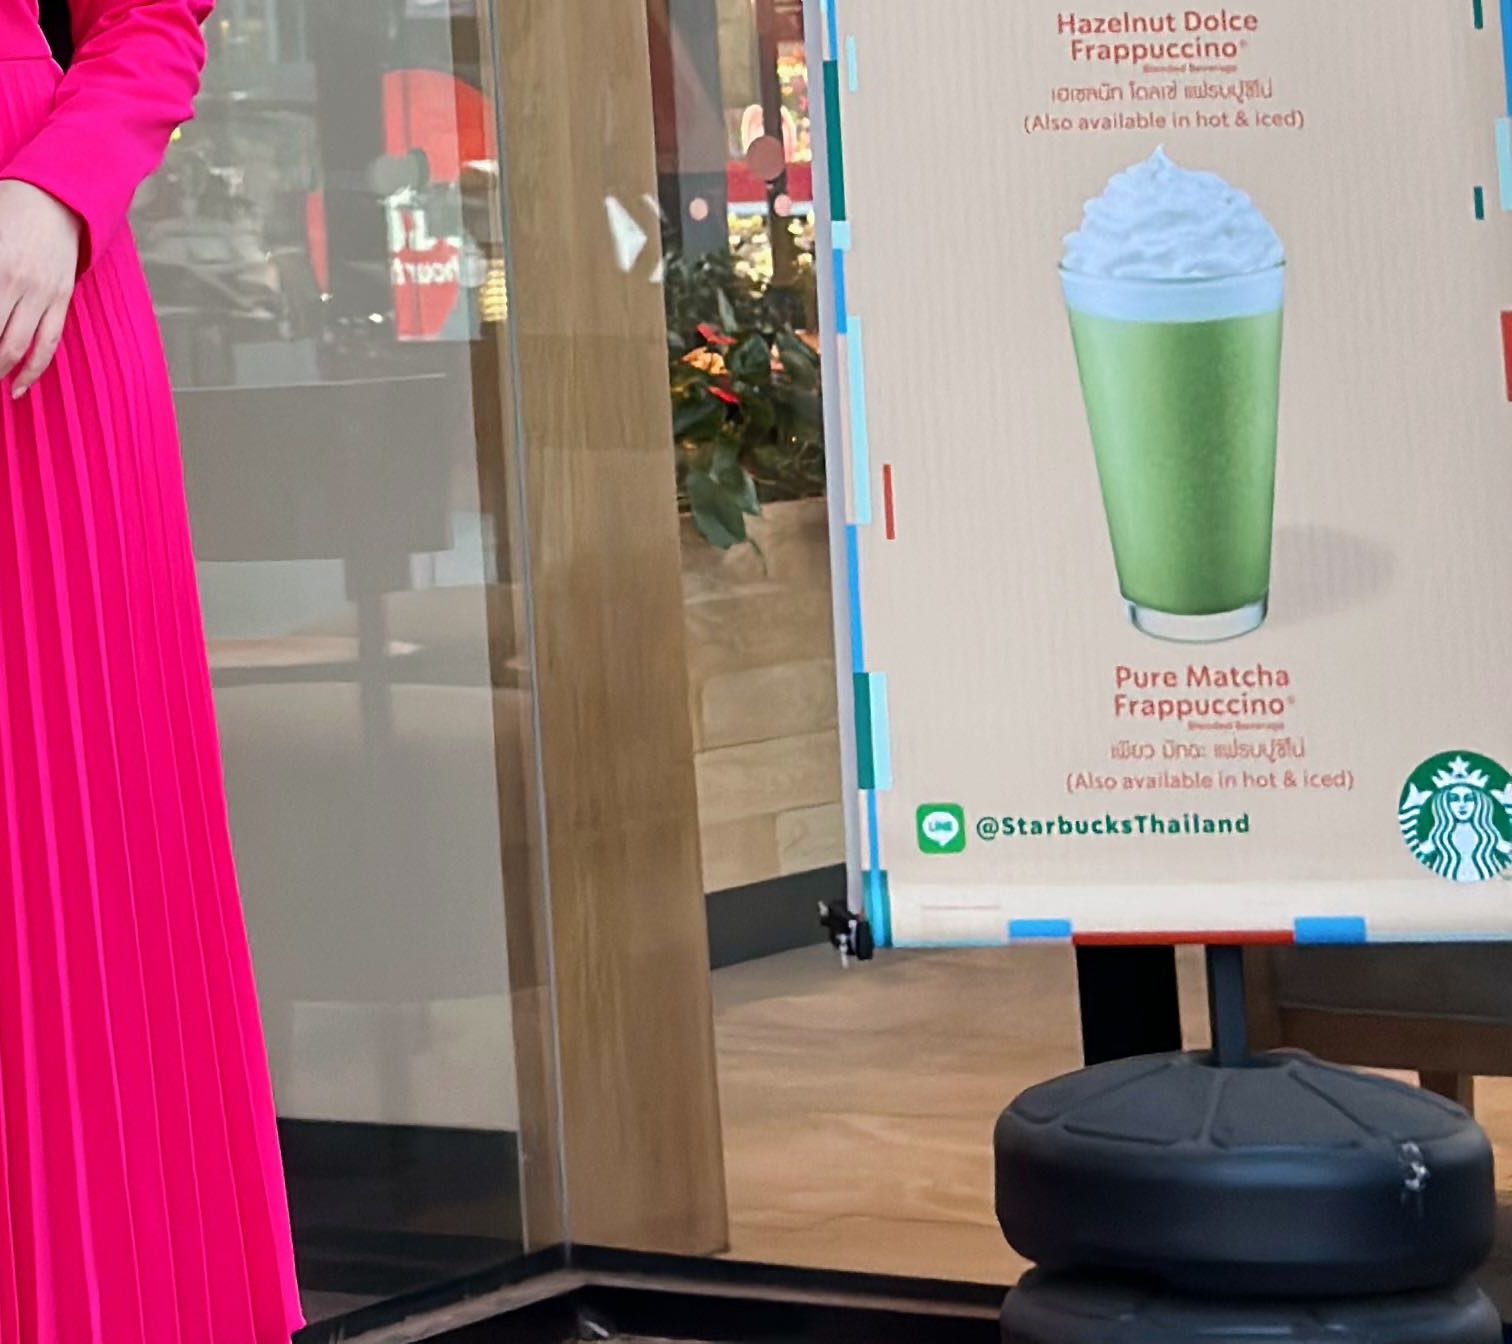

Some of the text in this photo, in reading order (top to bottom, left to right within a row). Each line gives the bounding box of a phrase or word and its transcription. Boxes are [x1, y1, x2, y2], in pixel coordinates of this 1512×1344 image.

[1057, 9, 1258, 34] Hazelnut Dolce
[1023, 110, 1305, 134] (Also available in hot & iced)
[1115, 664, 1291, 688] Pure Matcha
[1066, 769, 1355, 793] (Also available in hot & iced)
[976, 813, 1250, 840] @StarbucksThailand
